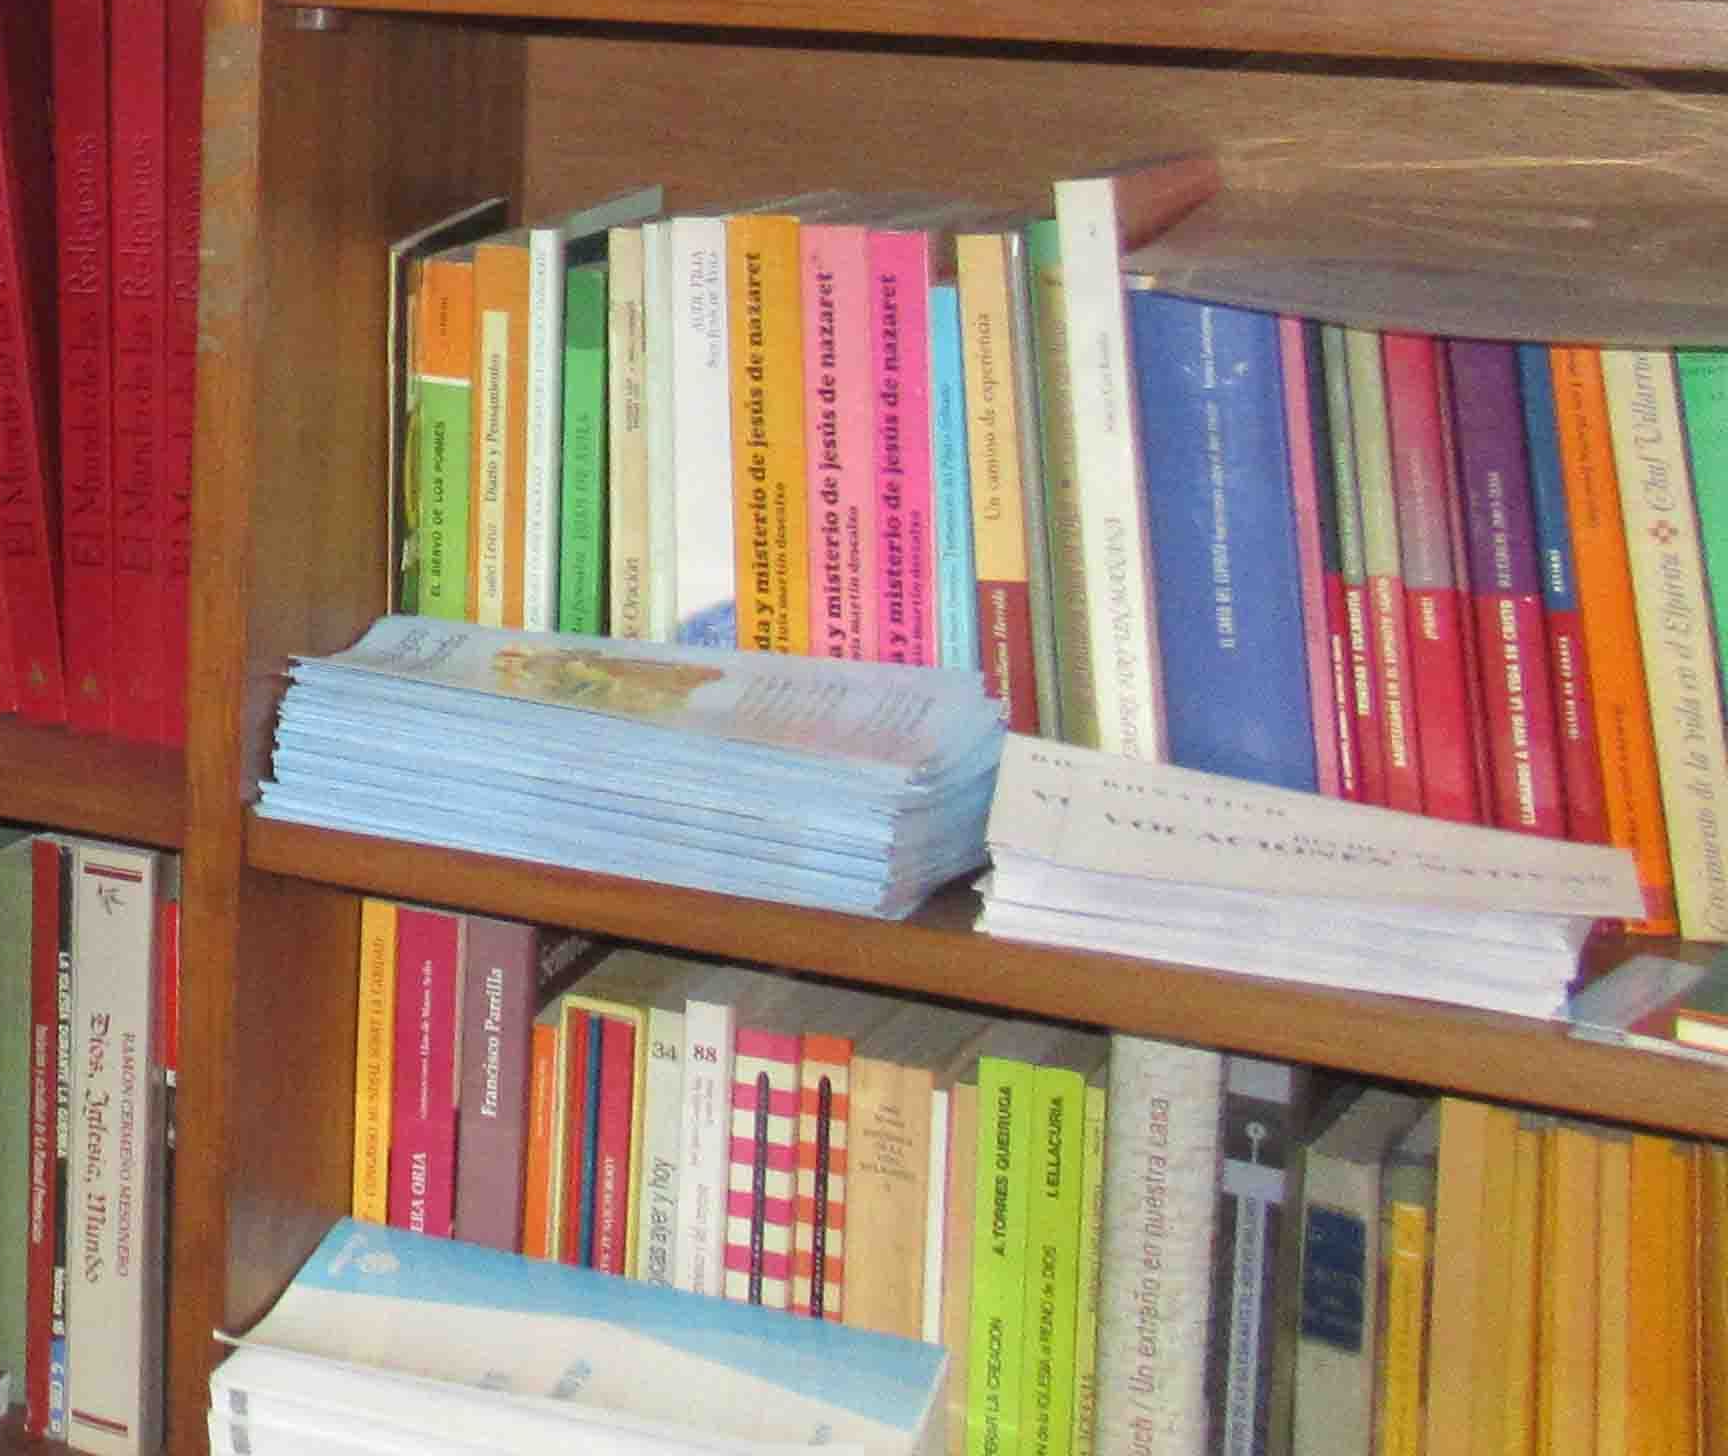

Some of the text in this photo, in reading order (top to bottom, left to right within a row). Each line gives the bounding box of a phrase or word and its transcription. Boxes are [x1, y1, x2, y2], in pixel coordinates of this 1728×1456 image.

[62, 131, 100, 296] Religiones
[433, 421, 447, 504] LOS POBRES
[484, 352, 502, 503] Diario Pensamientos
[742, 250, 770, 596] misterio de jesús de nazaret
[813, 271, 843, 620] misterio de jesús de nazaret
[878, 272, 905, 625] misterio de jesús de nazaret
[972, 313, 1002, 522] Un camino de experiencia
[772, 481, 789, 610] martín descalzo
[845, 505, 861, 634] martín descalzo
[1499, 600, 1517, 641] CRISTO
[1671, 695, 1716, 801] de Vida
[120, 1031, 137, 1097] RAMÓN
[479, 967, 505, 1118] Francisco Parrilla
[650, 1039, 677, 1062] 34
[692, 1044, 718, 1064] 88
[81, 1011, 111, 1284] Dios, Iglesia, Mundo
[411, 1151, 428, 1195] ORIA
[648, 1155, 674, 1190] hoy
[992, 1085, 1013, 1240] TORRES QUEIRUGA
[116, 1183, 134, 1277] MESONERO
[1040, 1246, 1057, 1281] DIOS
[1128, 1097, 1170, 1394] Un extraño en nuestra casa
